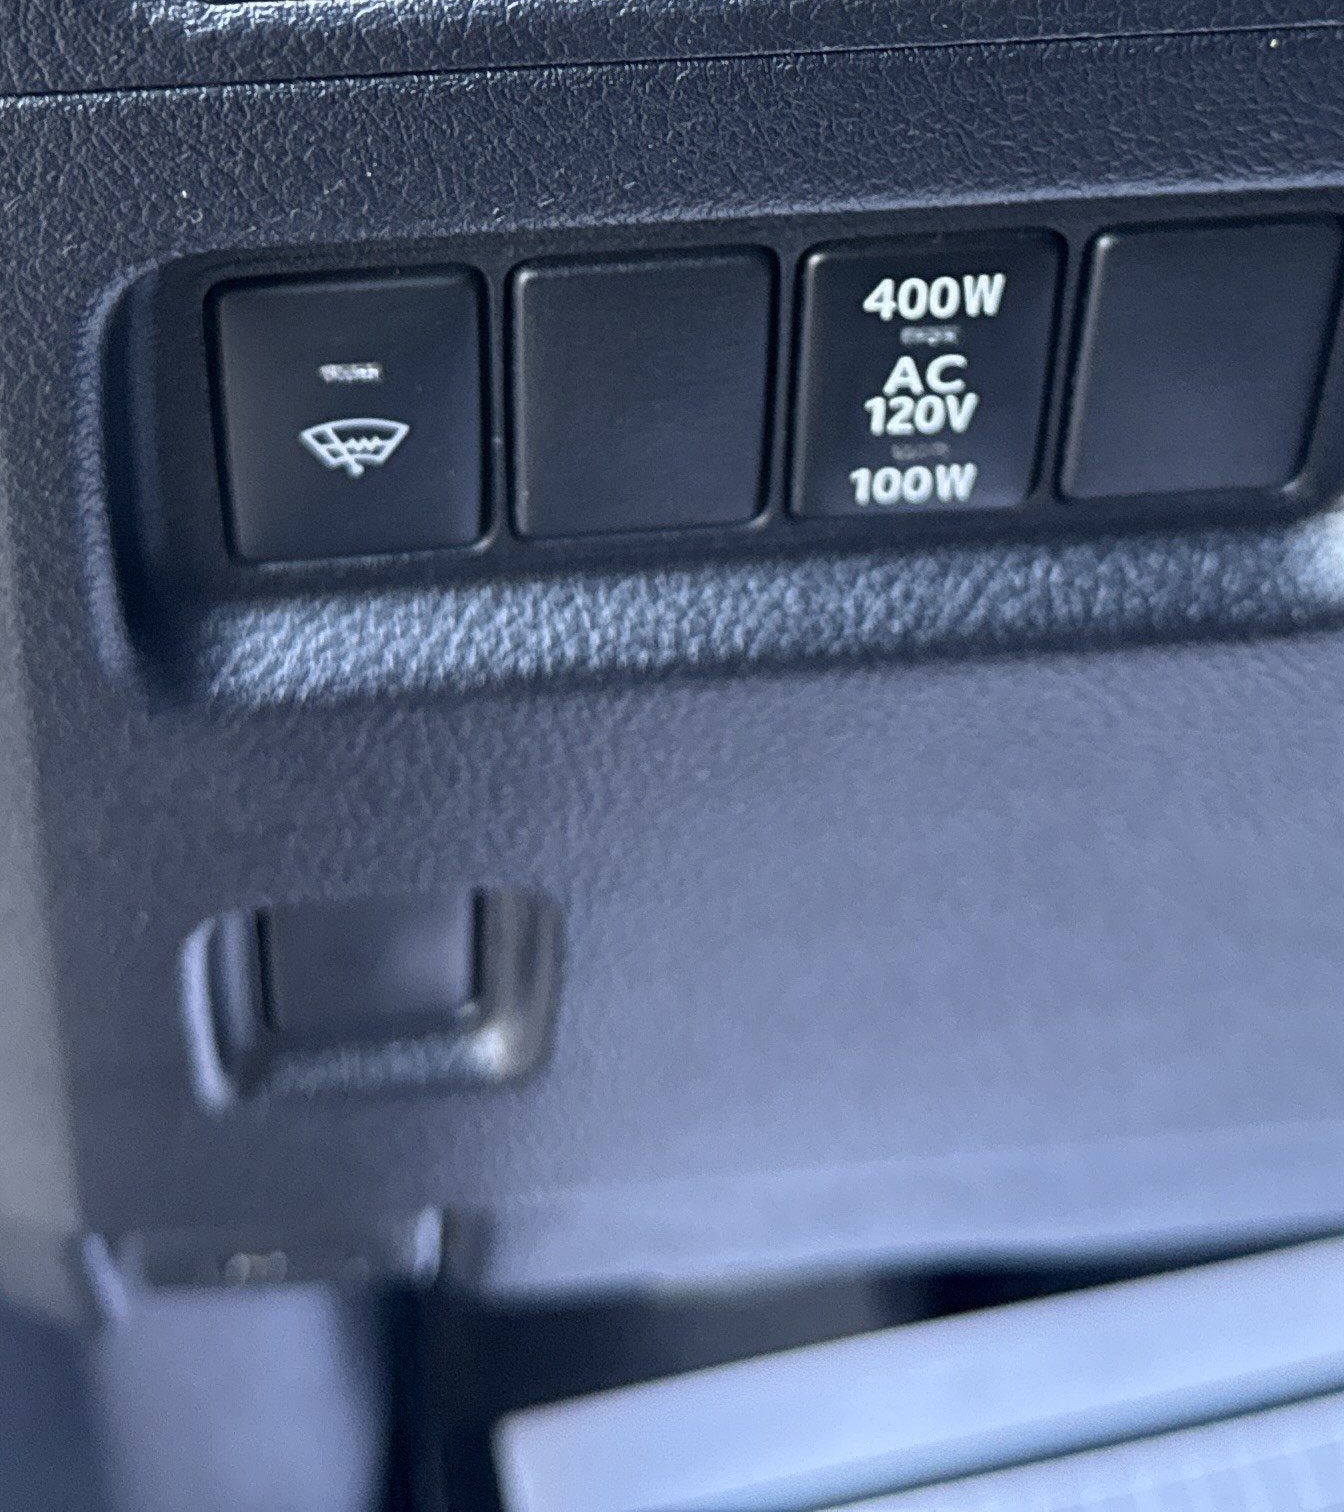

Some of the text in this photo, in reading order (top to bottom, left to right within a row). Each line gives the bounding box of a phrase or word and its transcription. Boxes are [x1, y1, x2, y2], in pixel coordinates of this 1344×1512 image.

[862, 272, 1006, 322] 400W
[882, 353, 968, 397] AC
[863, 392, 980, 436] 120V
[849, 462, 978, 507] 100W
